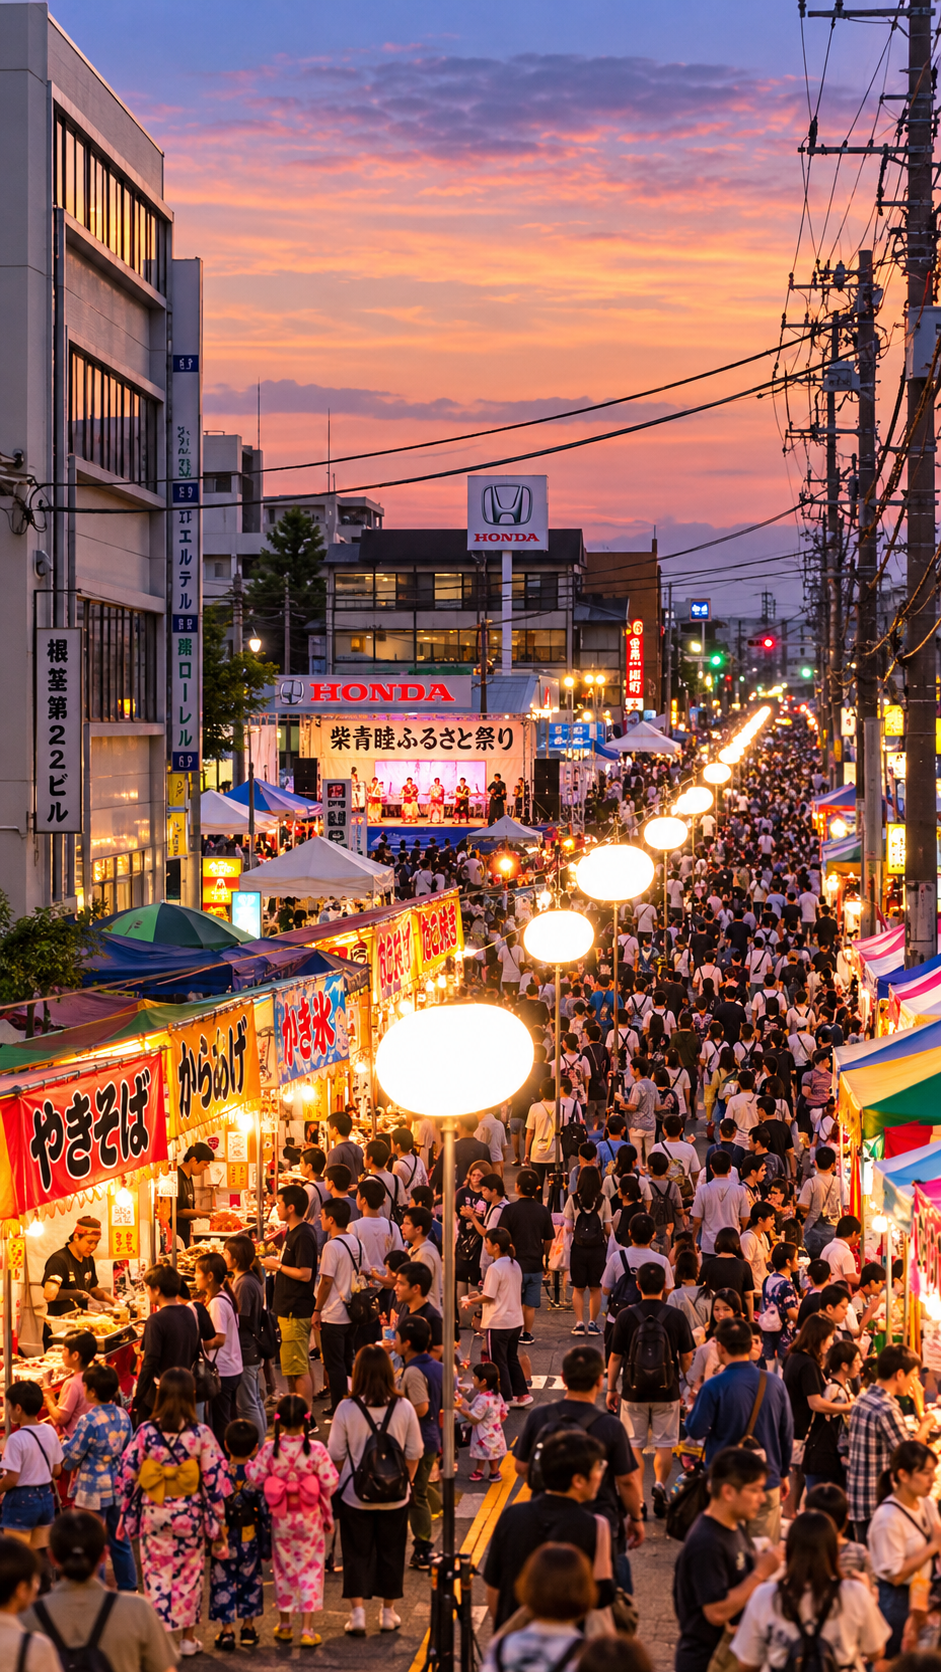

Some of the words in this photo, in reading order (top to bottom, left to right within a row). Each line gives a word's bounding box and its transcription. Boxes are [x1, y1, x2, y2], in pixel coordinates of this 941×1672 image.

[474, 533, 540, 543] HONDA
[309, 683, 455, 702] HONDA
[178, 1014, 248, 1120] からあげ
[281, 990, 336, 1067] かき氷
[31, 1066, 151, 1193] やきそば
